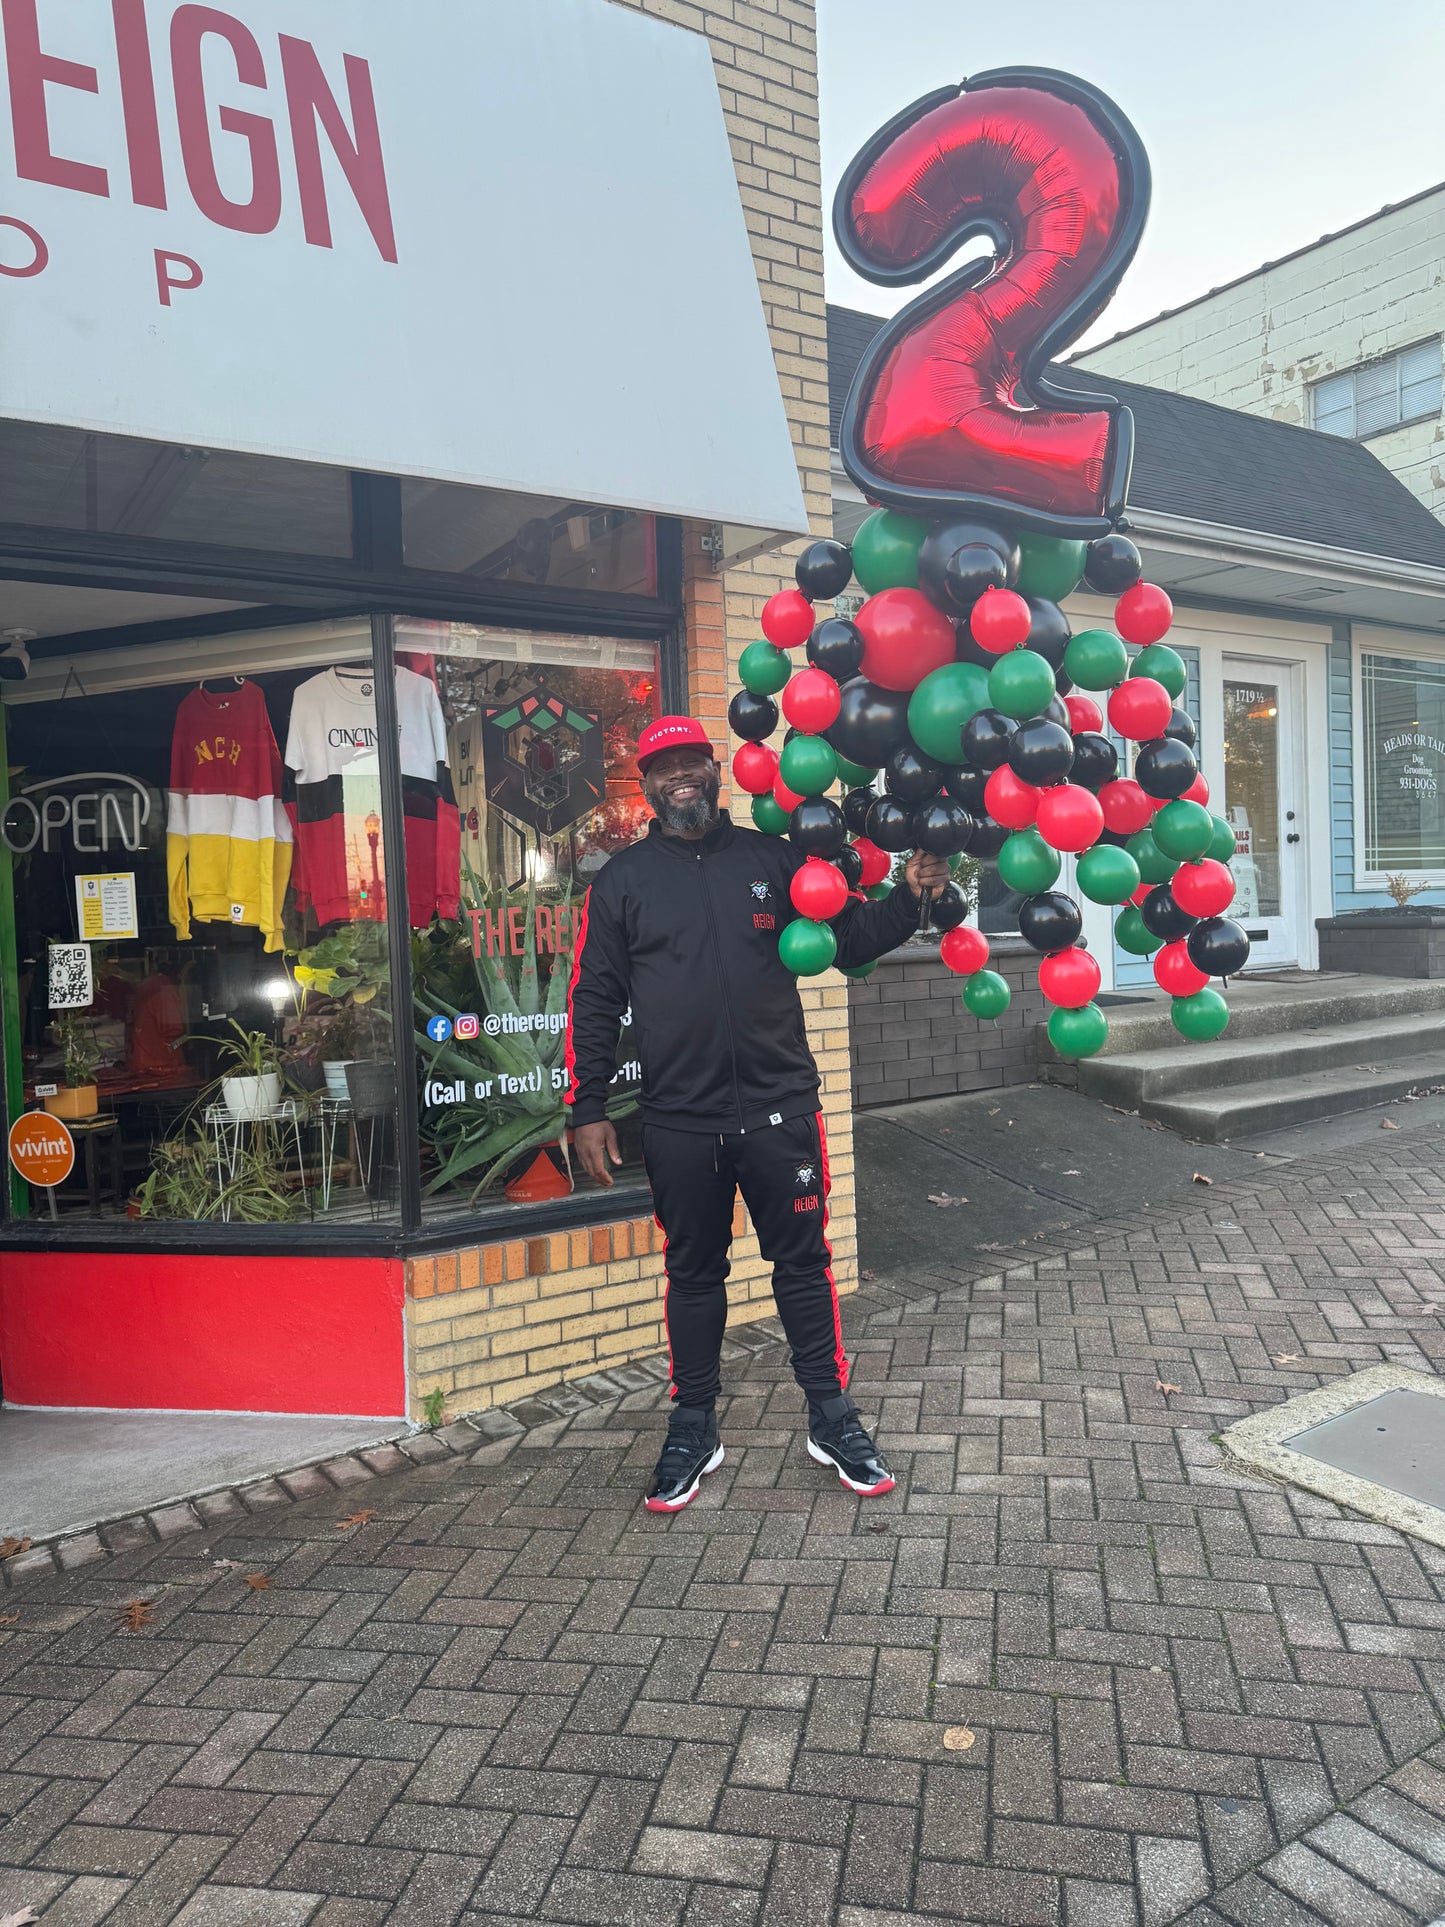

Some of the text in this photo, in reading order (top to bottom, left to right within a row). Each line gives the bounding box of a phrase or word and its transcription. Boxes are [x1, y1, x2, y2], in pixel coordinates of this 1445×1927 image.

[1236, 689, 1255, 703] 1719
[649, 726, 692, 743] VICTORY.
[1383, 733, 1412, 754] HEADS
[1413, 733, 1426, 746] OR
[1412, 753, 1424, 766] Dog
[1403, 764, 1433, 778] Grooming
[1399, 777, 1437, 790] 931-DOGS
[1, 792, 140, 854] OPEN
[752, 913, 776, 930] REIGN
[466, 905, 583, 959] THE REI
[424, 1080, 466, 1108] (Call
[474, 1079, 493, 1100] or
[498, 1065, 543, 1096] Text)
[551, 1067, 573, 1090] 51
[14, 1136, 69, 1158] vivint
[794, 1194, 819, 1213] REIGN
